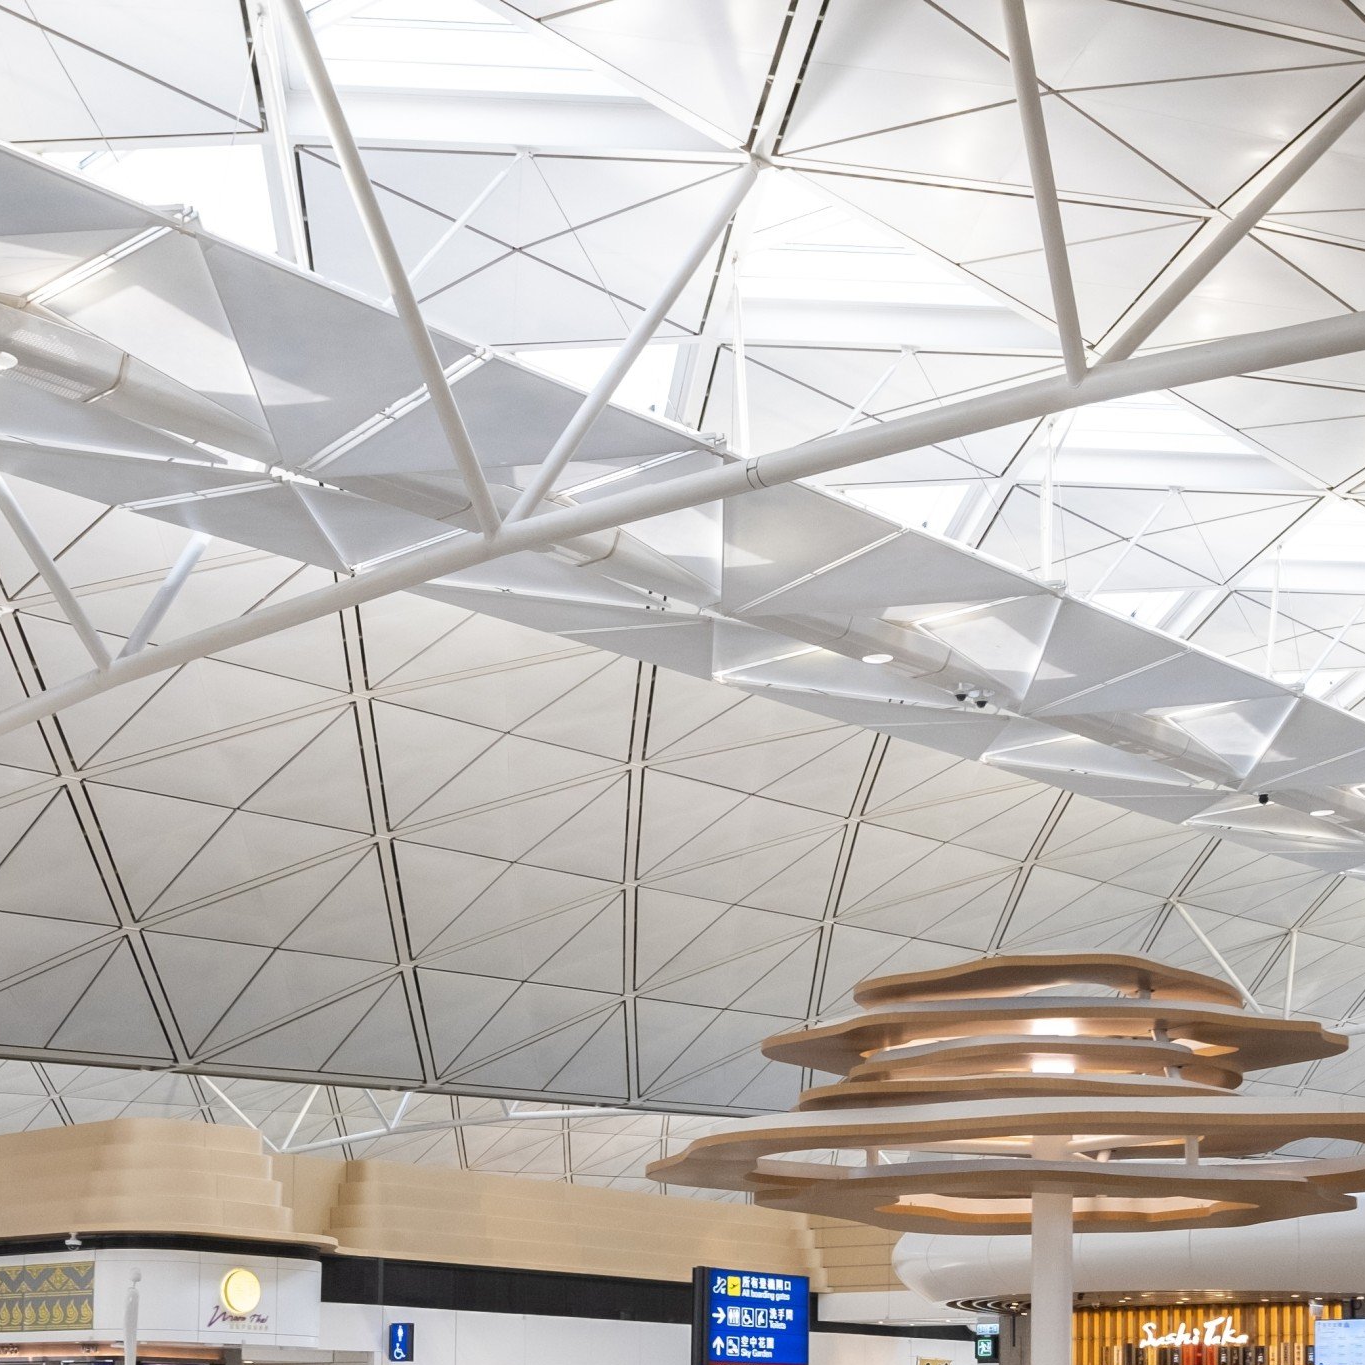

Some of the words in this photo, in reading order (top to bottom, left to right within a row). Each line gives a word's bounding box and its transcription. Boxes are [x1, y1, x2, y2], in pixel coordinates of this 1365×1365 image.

[742, 1289, 750, 1297] All
[751, 1290, 774, 1301] boarding
[776, 1292, 790, 1301] gates
[769, 1307, 793, 1321] 洗手間
[769, 1320, 787, 1329] Toilets
[1139, 1322, 1201, 1348] Sushi
[741, 1335, 774, 1349] 空中花園
[741, 1348, 751, 1358] Sky
[752, 1349, 773, 1358] Garden
